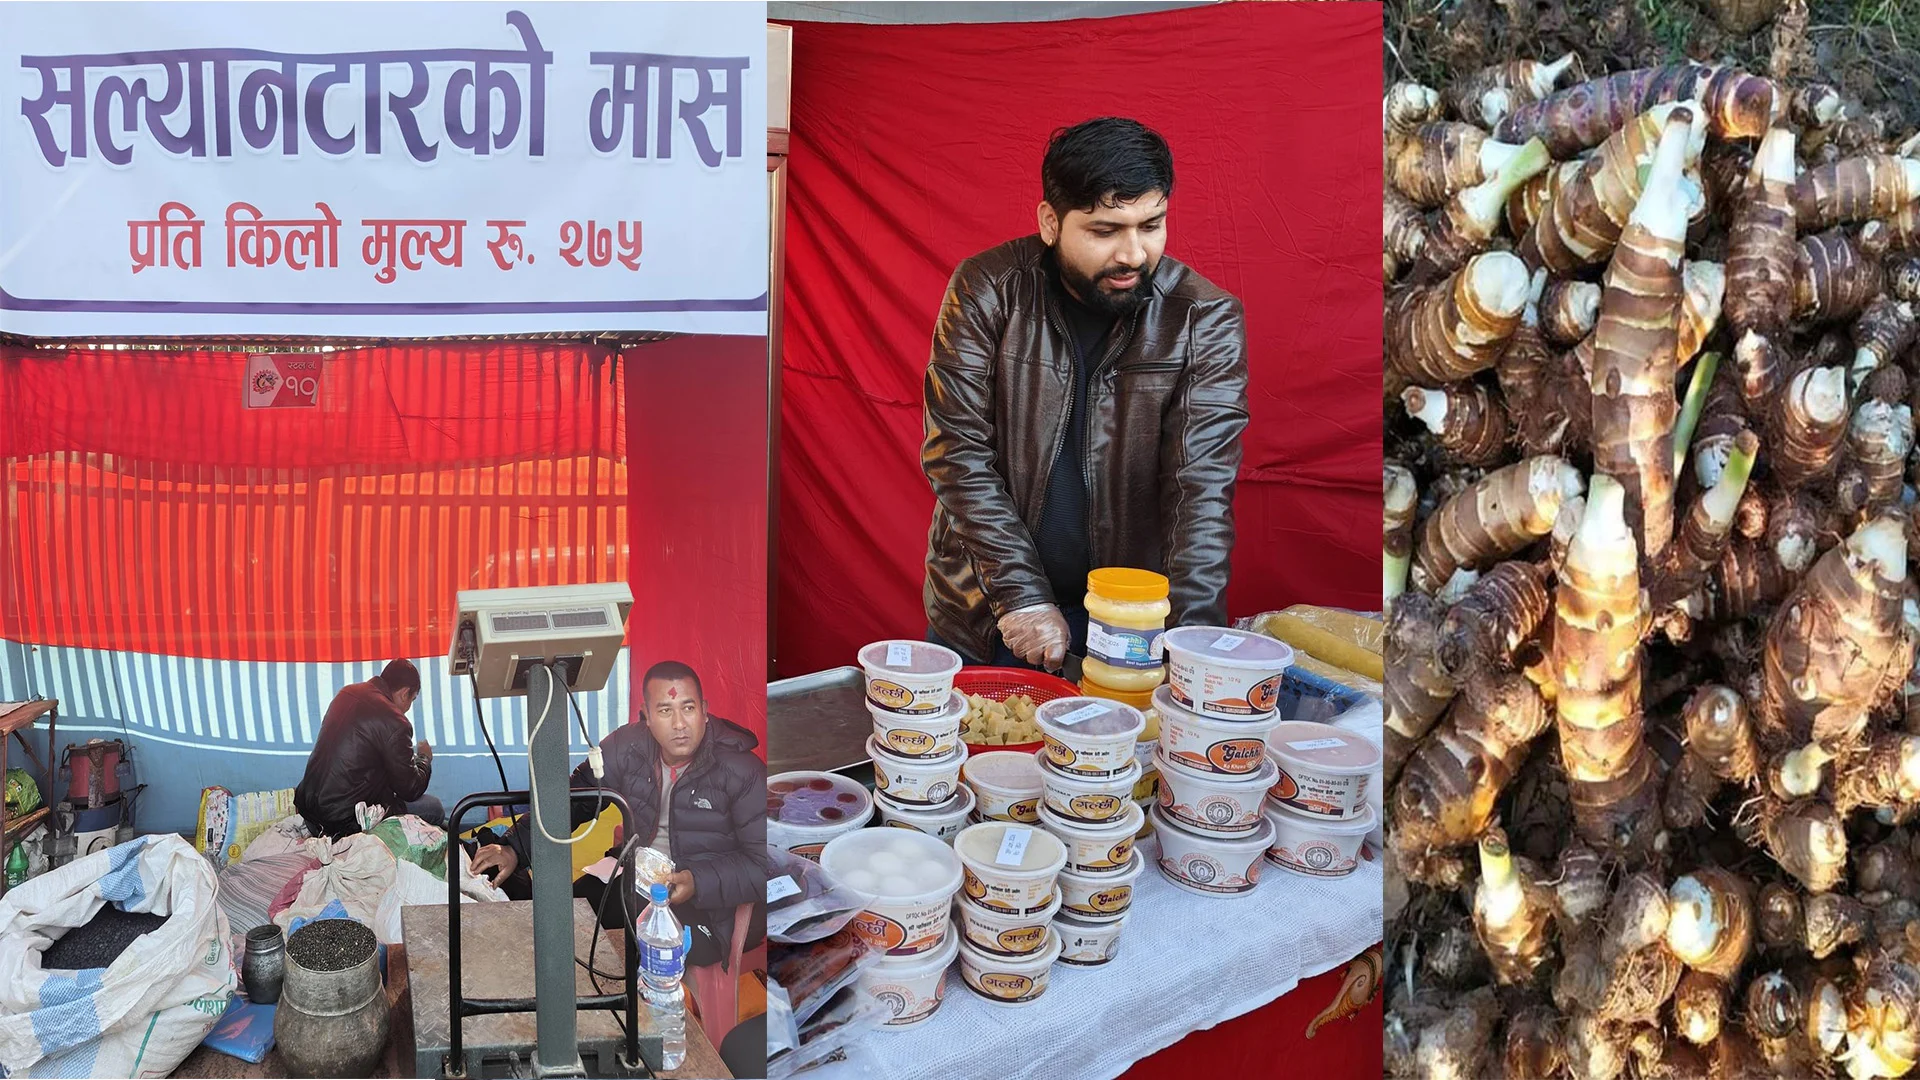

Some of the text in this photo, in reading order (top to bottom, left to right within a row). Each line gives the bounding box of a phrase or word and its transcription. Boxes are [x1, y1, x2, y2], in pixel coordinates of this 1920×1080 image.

[20, 11, 750, 167] सल्यानटारको मास
[127, 202, 204, 273] प्रति
[225, 203, 341, 270] किलो
[362, 220, 467, 284] मुल्य
[559, 220, 642, 271] २७५
